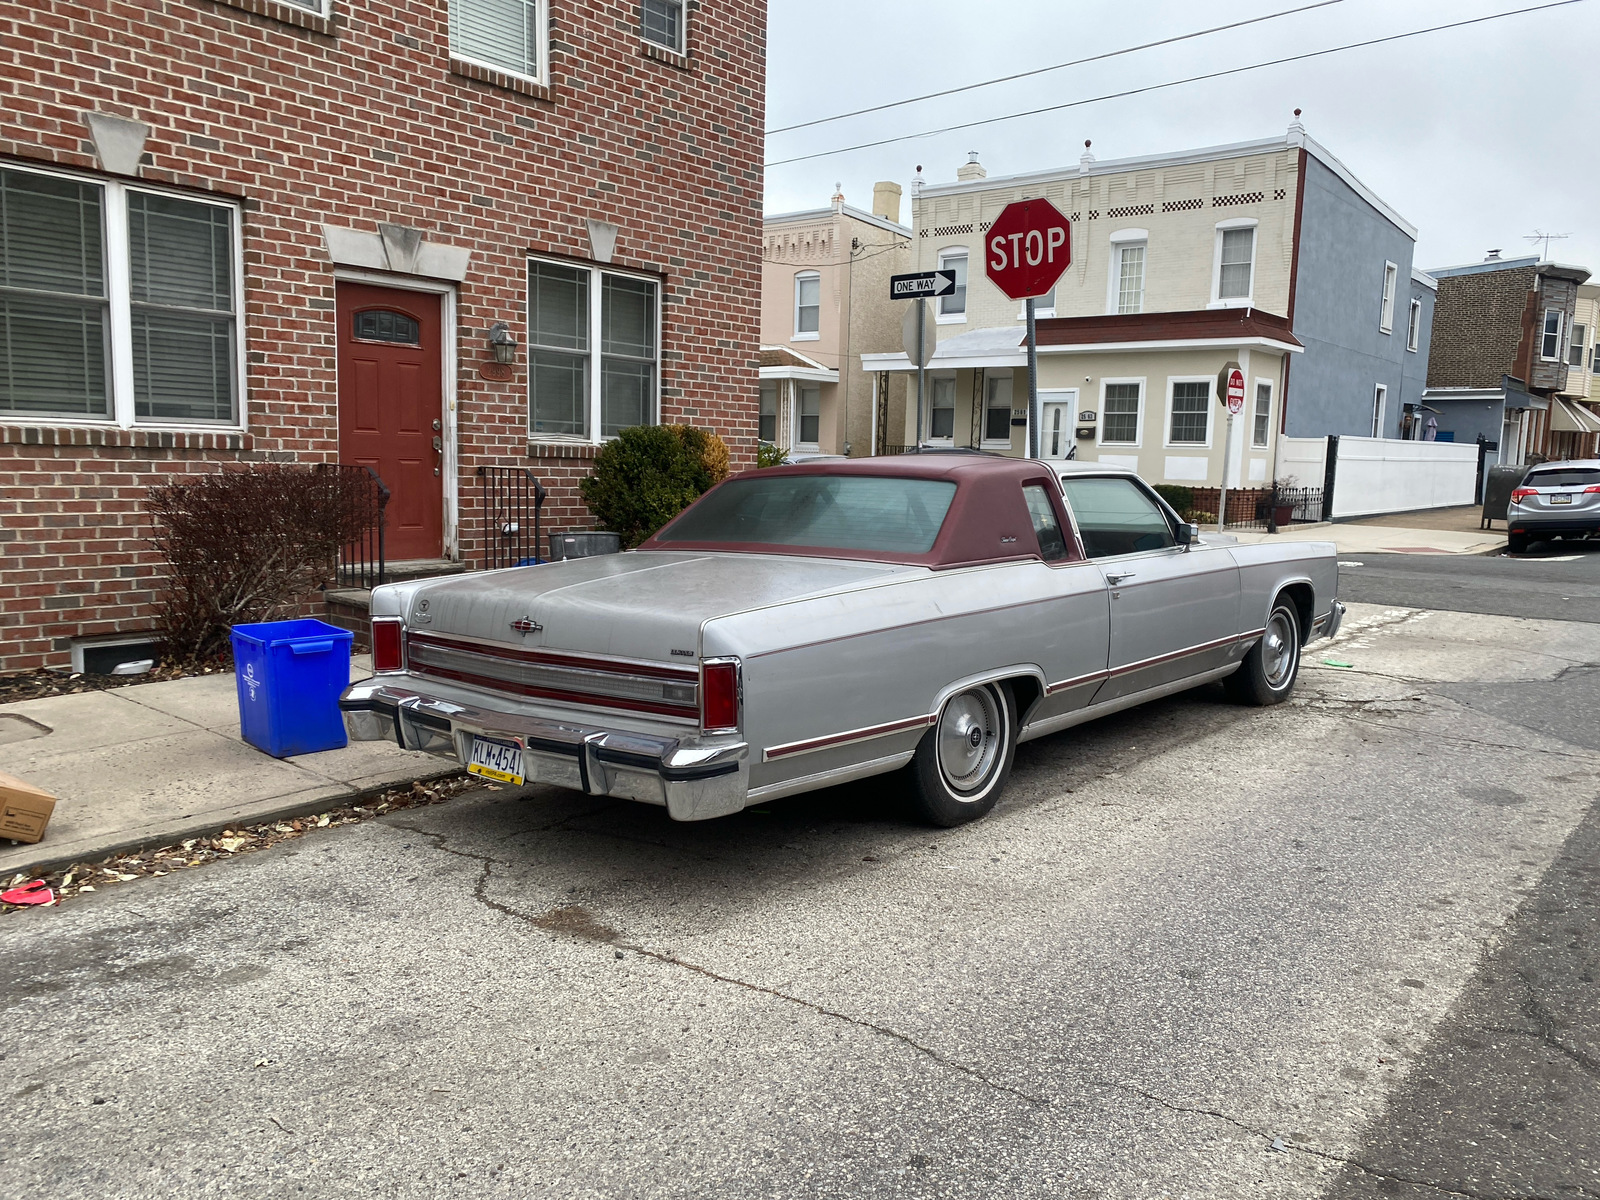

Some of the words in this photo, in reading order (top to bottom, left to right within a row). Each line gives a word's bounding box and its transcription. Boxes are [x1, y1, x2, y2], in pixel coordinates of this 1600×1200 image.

[990, 226, 1065, 271] STOP
[896, 281, 913, 292] ONE
[916, 279, 935, 290] WAY
[1230, 378, 1235, 386] DO
